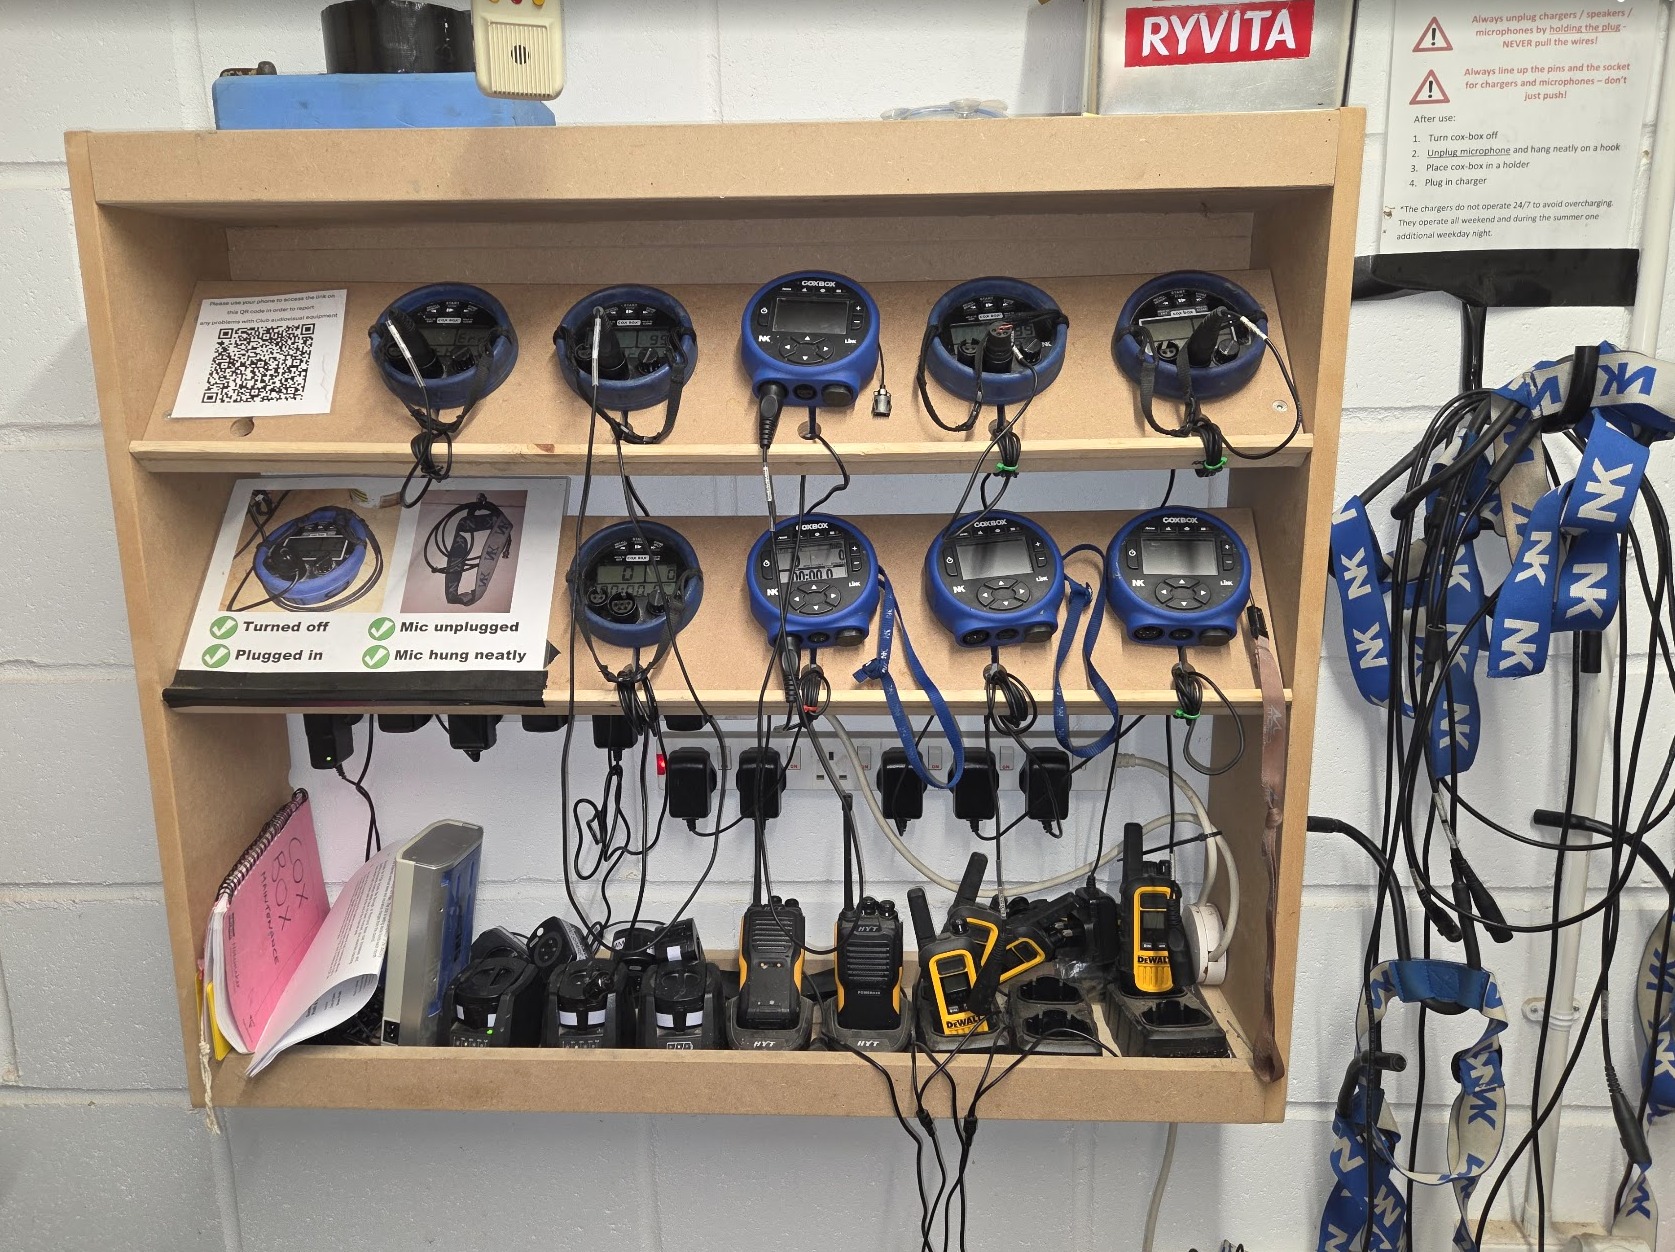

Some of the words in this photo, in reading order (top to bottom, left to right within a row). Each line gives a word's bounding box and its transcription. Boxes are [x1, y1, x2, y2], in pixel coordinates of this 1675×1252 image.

[1472, 14, 1504, 24] Always
[1506, 13, 1536, 23] unplug
[1539, 11, 1577, 21] chargers
[1586, 9, 1625, 19] speakers
[1142, 9, 1295, 57] RYVITA
[1476, 27, 1533, 36] microphones
[1536, 25, 1547, 35] by
[1550, 24, 1582, 34] holding
[1585, 24, 1599, 33] the
[1602, 23, 1620, 33] plug
[1503, 40, 1532, 48] NEVER
[1535, 38, 1551, 48] pull
[1554, 38, 1568, 46] the
[1571, 36, 1598, 45] wires!
[1464, 67, 1496, 77] Always
[1498, 66, 1514, 75] line
[1548, 64, 1565, 74] pins
[1568, 64, 1584, 72] and
[1586, 63, 1600, 71] the
[1603, 62, 1630, 71] socket
[1481, 80, 1517, 90] chargers
[1520, 79, 1536, 87] and
[1539, 77, 1594, 87] microphones
[1524, 92, 1541, 101] just
[1543, 91, 1567, 100] push!
[1414, 115, 1436, 123] After
[1429, 133, 1448, 142] Turn
[1450, 132, 1483, 141] cox-box
[1486, 131, 1498, 140] off
[1427, 149, 1457, 158] Unplug
[1460, 146, 1511, 158] microphone
[1513, 146, 1528, 154] and
[1530, 146, 1551, 154] hang
[1553, 144, 1578, 154] neatly
[1600, 143, 1620, 151] hook
[1450, 161, 1483, 171] cox-box
[1486, 161, 1494, 169] in
[1503, 161, 1530, 169] holder
[1425, 178, 1443, 188] Plug
[1445, 178, 1453, 186] in
[1455, 177, 1487, 187] charger
[1421, 204, 1453, 213] chargers
[1482, 202, 1511, 211] operate
[1565, 199, 1613, 209] overcharging.
[1399, 219, 1416, 228] They
[1419, 217, 1448, 227] operate
[1461, 216, 1495, 224] weekend
[1513, 214, 1537, 223] during
[1397, 231, 1434, 240] additional
[1436, 230, 1470, 239] weekday
[1578, 457, 1634, 523] NK
[974, 519, 1007, 527] COXBOX
[1515, 532, 1552, 586] NK
[1340, 547, 1371, 600] NK
[1565, 563, 1608, 620] NK
[243, 621, 300, 632] Turned
[306, 621, 330, 632] off
[400, 622, 428, 632] Mic
[434, 622, 519, 634] unplugged
[1353, 622, 1388, 669] NK
[1500, 618, 1540, 672] NK
[235, 650, 302, 662] Plugged
[308, 650, 323, 661] in
[395, 650, 423, 661] Mic
[429, 650, 469, 662] hung
[475, 650, 526, 662] neatly
[288, 837, 308, 908] COX
[272, 850, 292, 930] BOX
